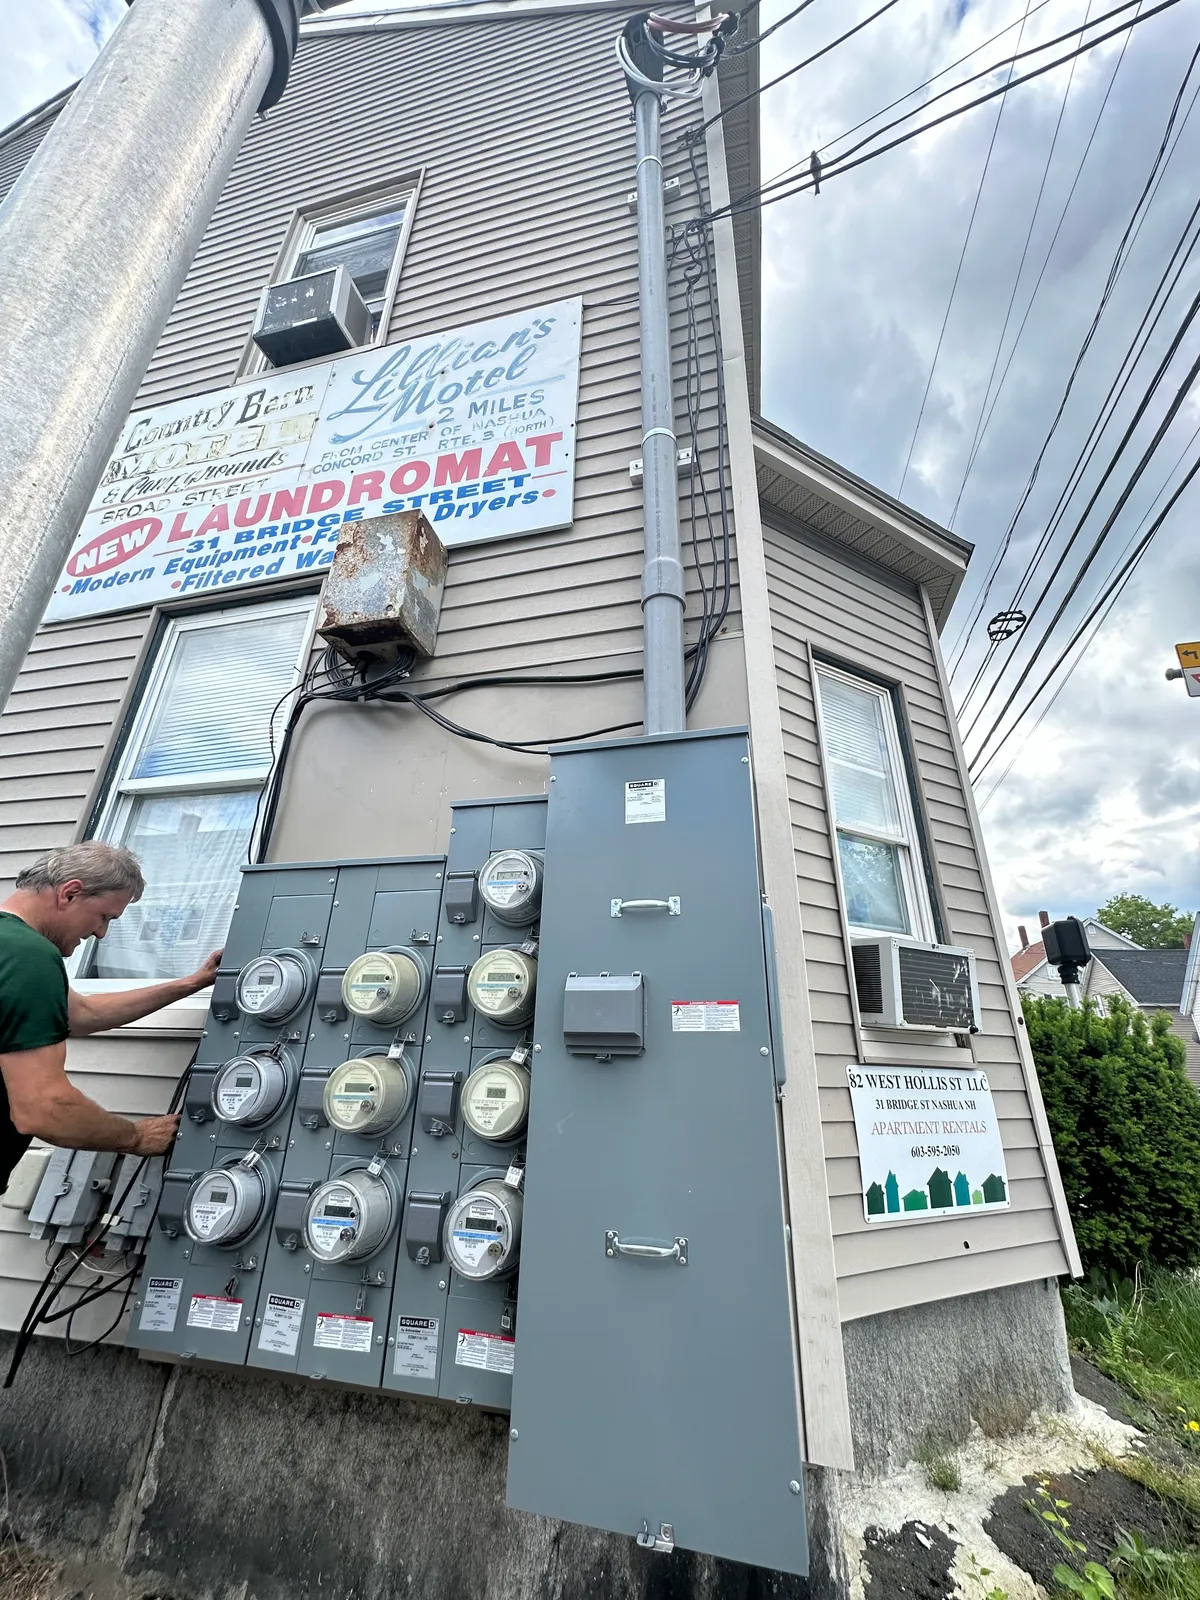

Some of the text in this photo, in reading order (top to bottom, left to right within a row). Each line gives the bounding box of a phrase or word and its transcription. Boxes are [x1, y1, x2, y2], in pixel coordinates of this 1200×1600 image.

[326, 317, 556, 421] Lillian's
[329, 343, 537, 445] Motel
[437, 389, 545, 424] 2 MILES
[124, 397, 239, 453] Country
[321, 408, 546, 462] FROM CENTER OF NASHUA
[121, 446, 289, 503] Campgrounds
[312, 451, 383, 475] CONCORD
[393, 446, 416, 458] ST.
[438, 434, 476, 450] RTE.
[483, 430, 495, 441] 3
[100, 477, 271, 525] BROAD STREET
[167, 431, 563, 543] LAUNDROMAT
[186, 473, 531, 553] 31 BRIDGE STREET
[69, 490, 539, 595] Modern Equipment Fa Dryers
[75, 523, 153, 575] NEW
[179, 557, 285, 592] Filtered
[848, 1073, 988, 1092] 82 WEST HOLLIS ST LLC
[875, 1099, 976, 1110] 31 BRIDGE ST NASHUA NH
[871, 1120, 987, 1135] APARTMENT RENTALS
[910, 1144, 960, 1158] 603-595-2050
[270, 1297, 294, 1307] SQUARE
[401, 1319, 428, 1327] SQUARE
